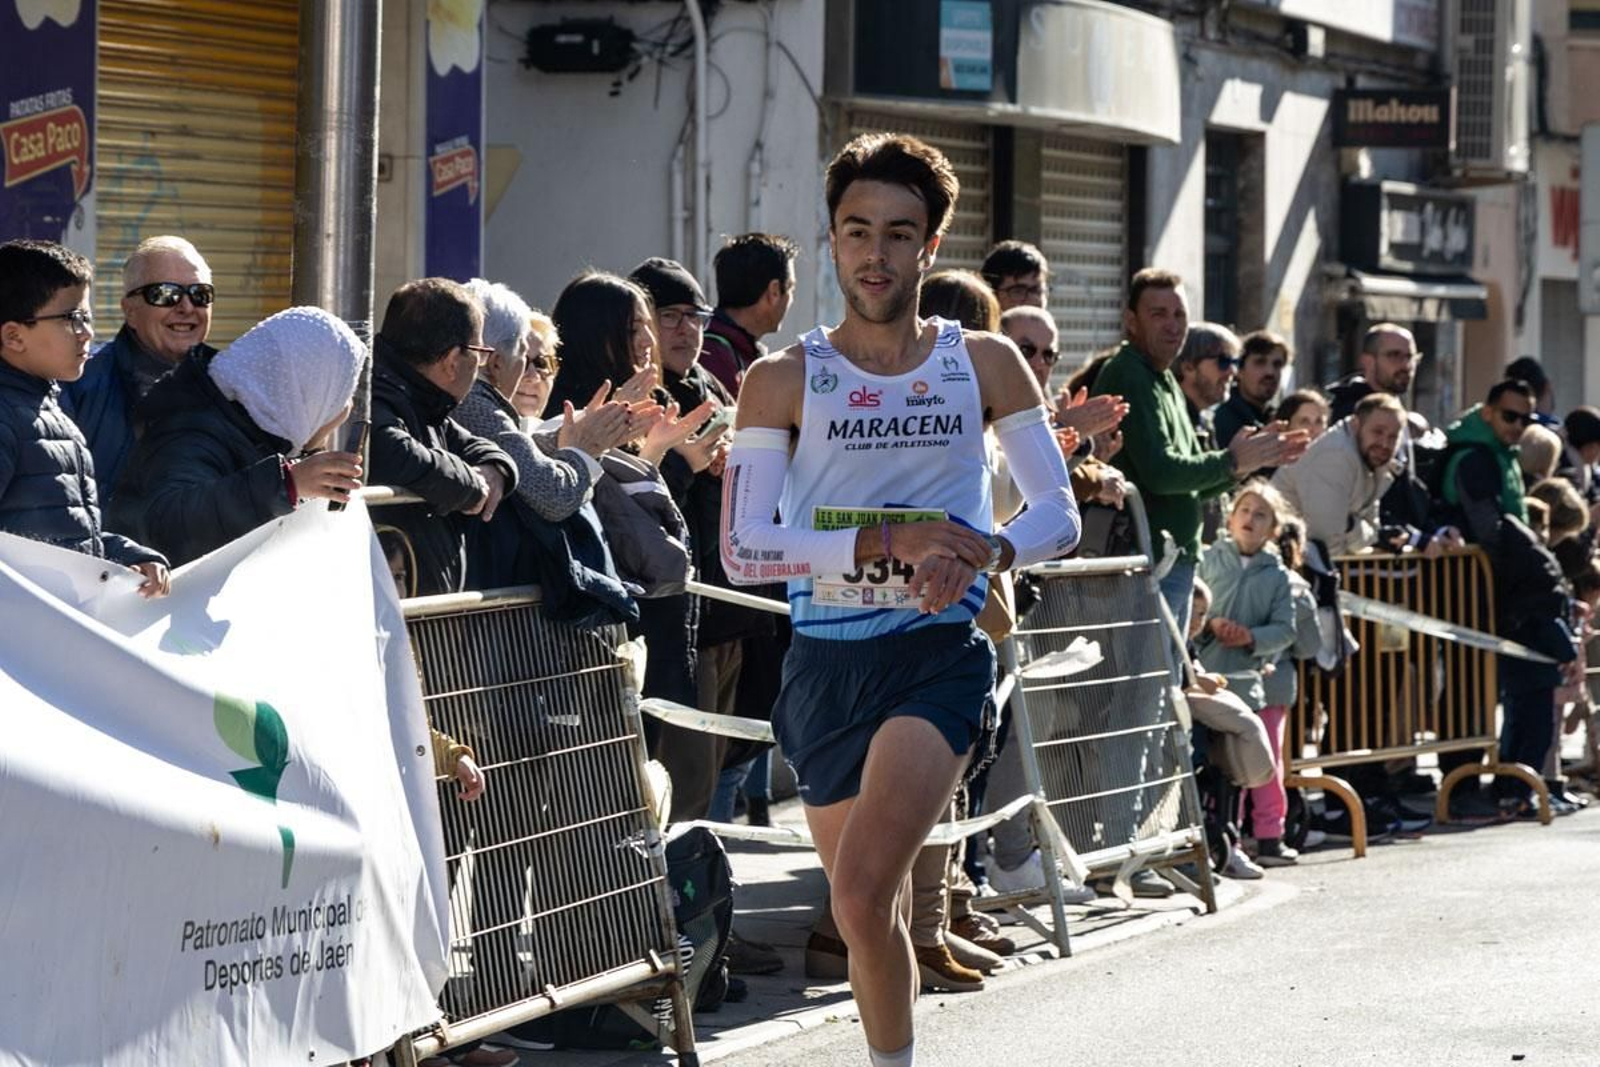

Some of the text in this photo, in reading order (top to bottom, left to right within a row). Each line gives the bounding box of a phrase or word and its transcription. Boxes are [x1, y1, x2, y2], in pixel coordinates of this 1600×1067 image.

[10, 121, 81, 164] Casa Paco
[827, 414, 963, 440] MARACENA
[844, 439, 950, 451] CLUB DE ATLETISMO
[836, 511, 853, 524] SAN
[855, 512, 879, 524] JUAN
[743, 562, 759, 577] DEL
[181, 911, 266, 952] Patronato
[272, 894, 351, 937] Municipal
[204, 935, 354, 995] Deportes de Jaén
